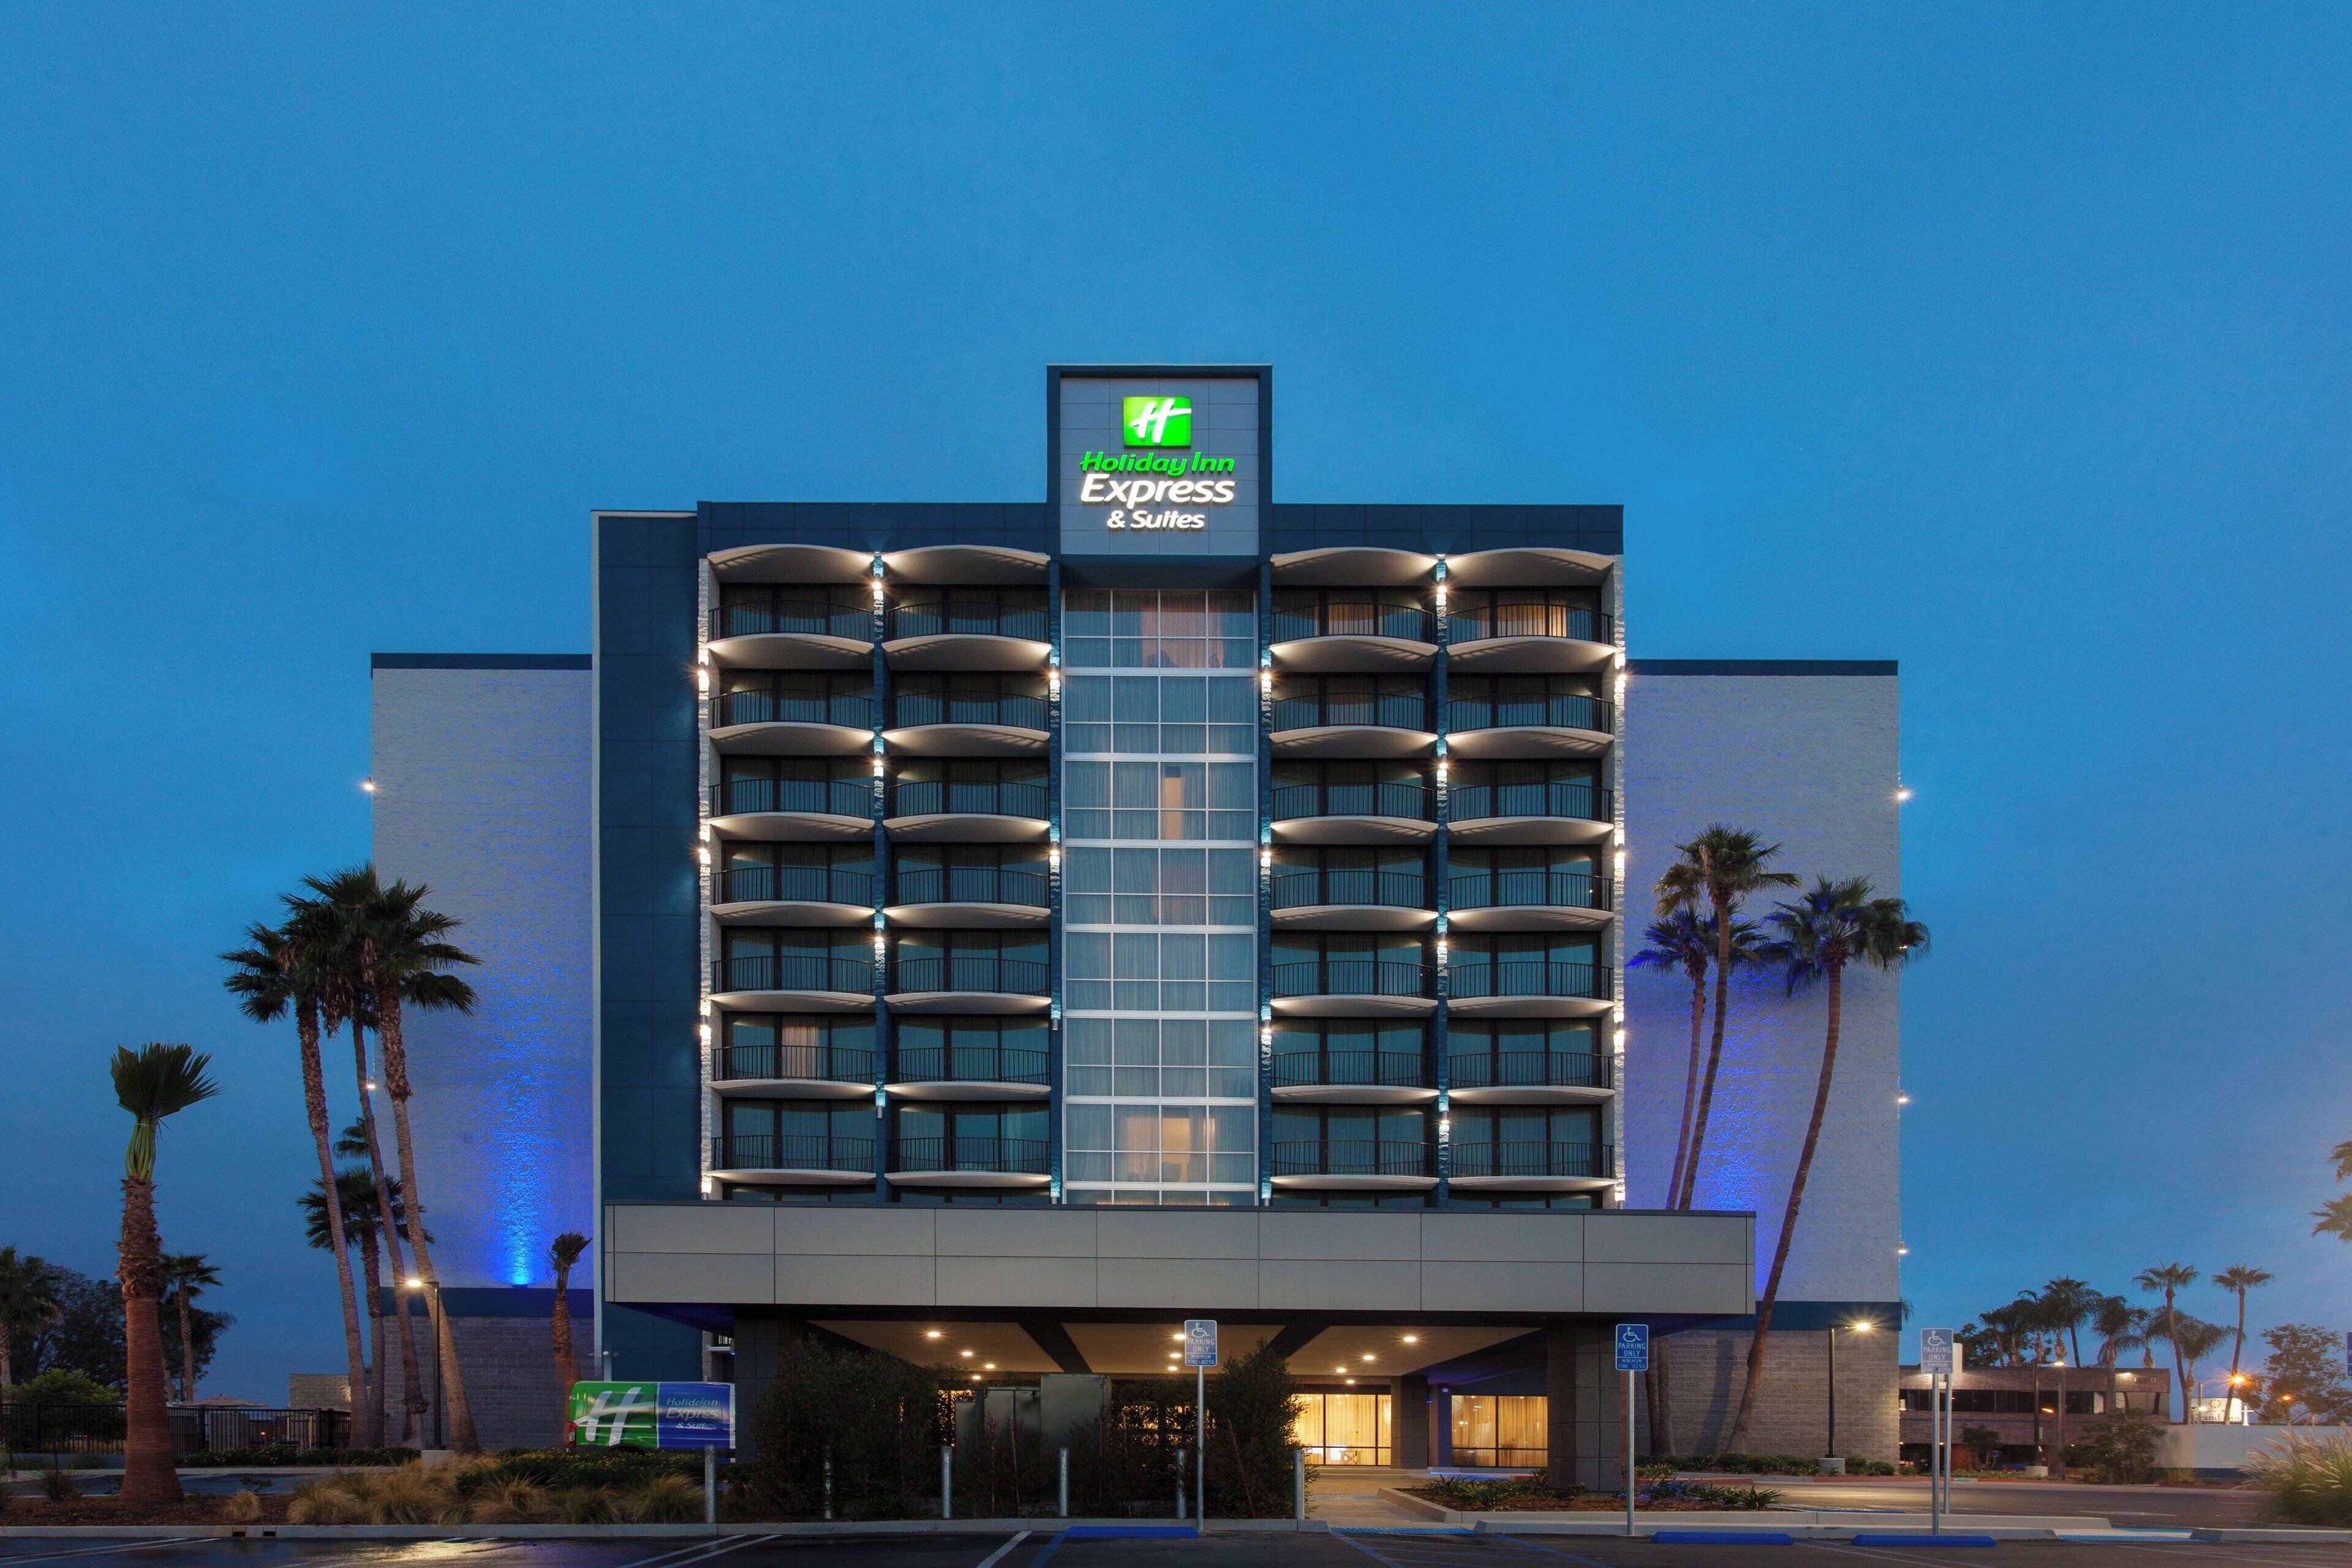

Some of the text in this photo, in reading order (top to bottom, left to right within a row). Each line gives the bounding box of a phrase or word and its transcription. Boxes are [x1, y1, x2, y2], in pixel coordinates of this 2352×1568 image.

[1080, 451, 1235, 477] Holiday Inn
[1080, 473, 1236, 510] Express
[1107, 510, 1205, 529] & Suites
